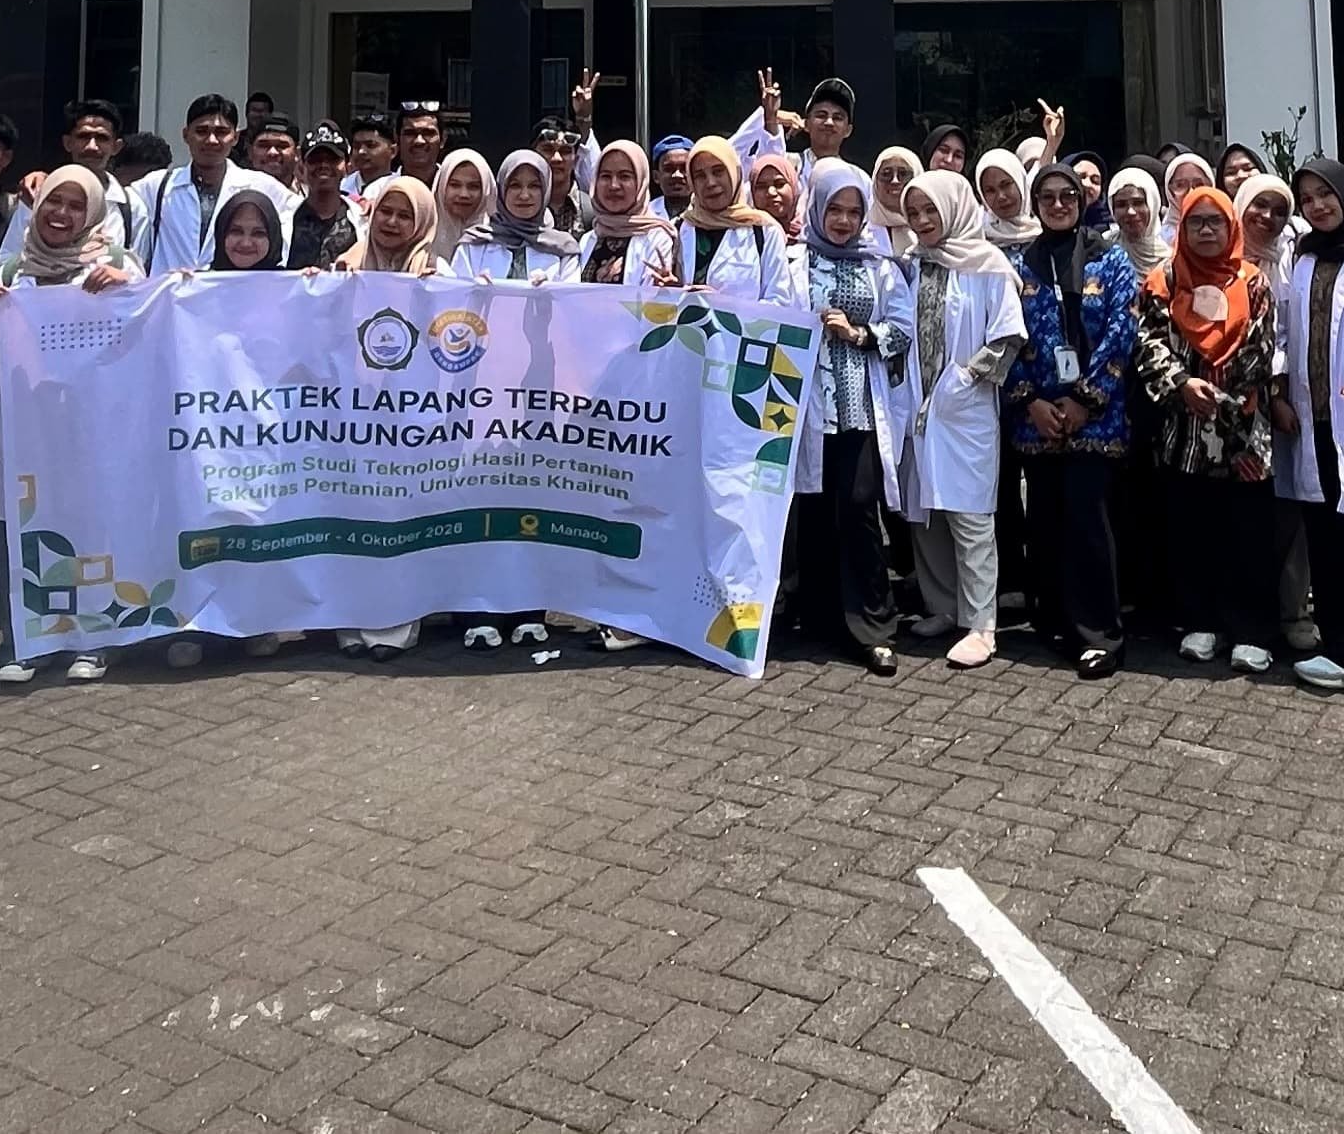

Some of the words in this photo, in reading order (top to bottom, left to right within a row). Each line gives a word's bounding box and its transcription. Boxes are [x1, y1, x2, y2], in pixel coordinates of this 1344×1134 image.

[174, 386, 342, 416] PRAKTEK
[353, 387, 493, 413] LAPANG
[504, 388, 667, 424] TERPADU
[169, 425, 244, 451] DAN
[257, 420, 473, 448] KUNJUNGAN
[484, 419, 673, 457] AKADEMIK
[203, 460, 296, 481] Program
[303, 456, 356, 474] Studi
[363, 452, 466, 476] Teknologi
[472, 452, 525, 467] Hasil
[532, 453, 634, 483] Pertanian
[207, 480, 298, 504] Fakultas
[305, 478, 413, 499] Pertanian,
[420, 472, 541, 494] Universitas
[547, 474, 629, 501] Khairun
[226, 537, 246, 549] 28
[251, 531, 331, 552] September
[346, 532, 356, 544] 4
[361, 529, 421, 547] Oktober
[551, 522, 608, 544] Manado
